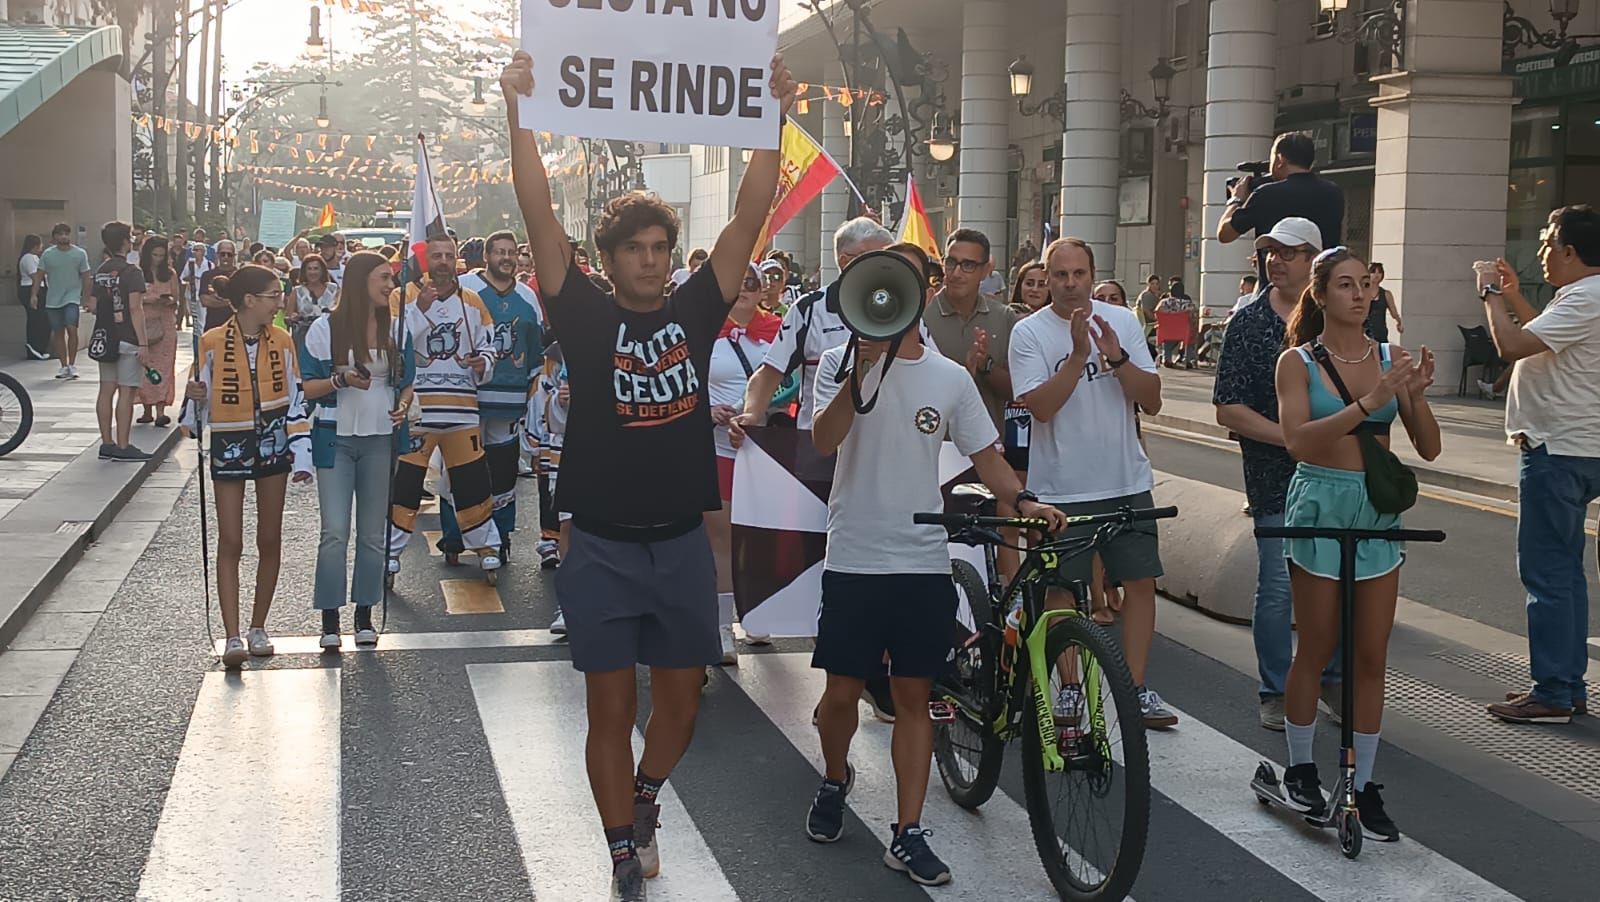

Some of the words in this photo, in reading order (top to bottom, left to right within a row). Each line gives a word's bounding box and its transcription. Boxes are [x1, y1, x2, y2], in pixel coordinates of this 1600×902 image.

[558, 55, 615, 110] SE
[630, 60, 764, 119] RINDE
[91, 340, 105, 354] 66
[269, 350, 283, 393] CLUB
[614, 355, 632, 371] NO
[614, 358, 698, 402] CEUTA
[616, 403, 633, 415] SE
